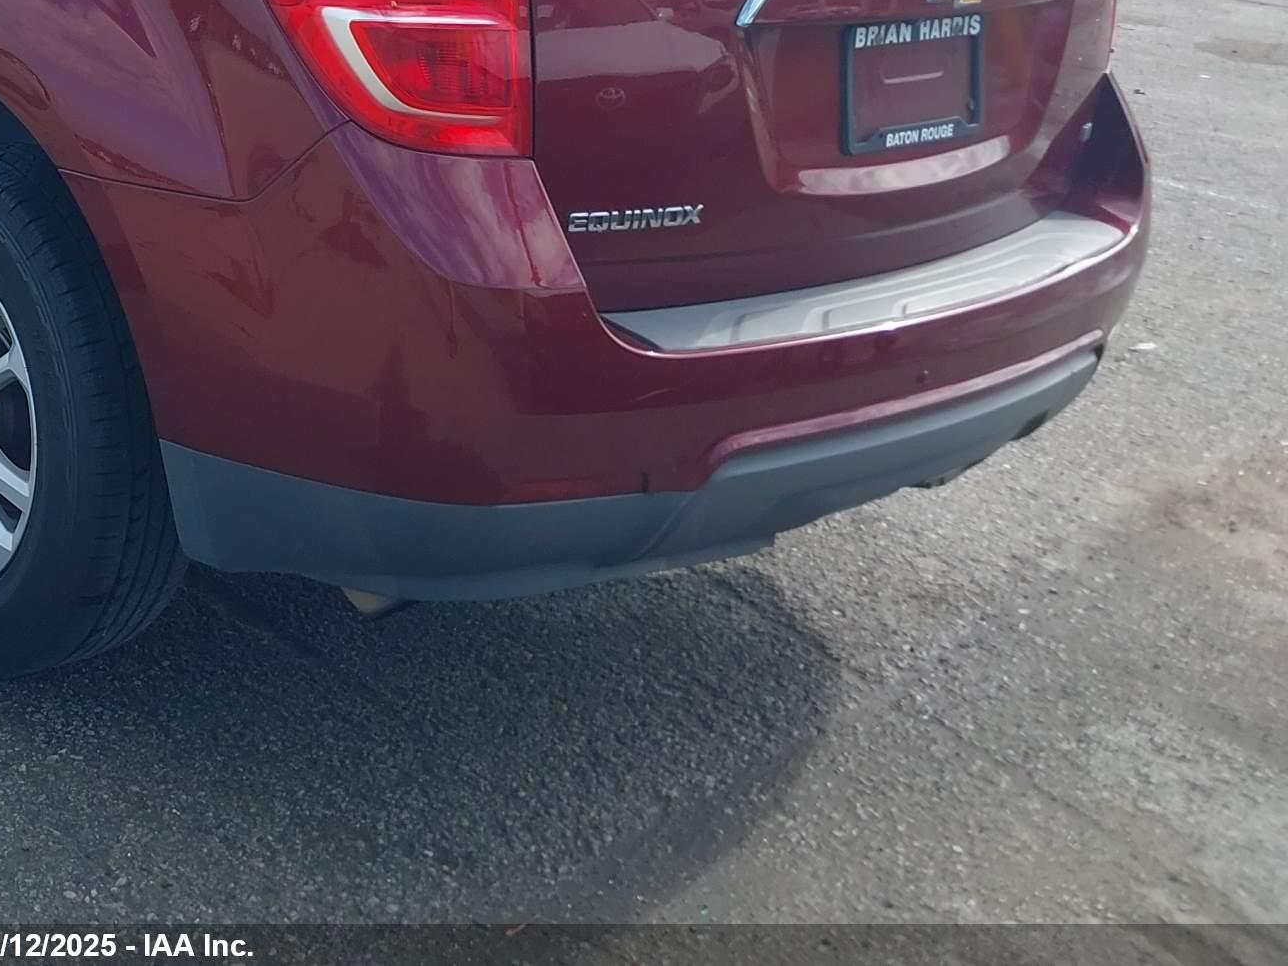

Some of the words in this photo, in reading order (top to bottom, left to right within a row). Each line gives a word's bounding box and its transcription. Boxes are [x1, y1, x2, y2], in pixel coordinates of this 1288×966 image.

[855, 22, 912, 48] BRIAN
[886, 130, 919, 147] BATON
[920, 124, 954, 142] ROUGE
[568, 204, 704, 233] EQUINOX
